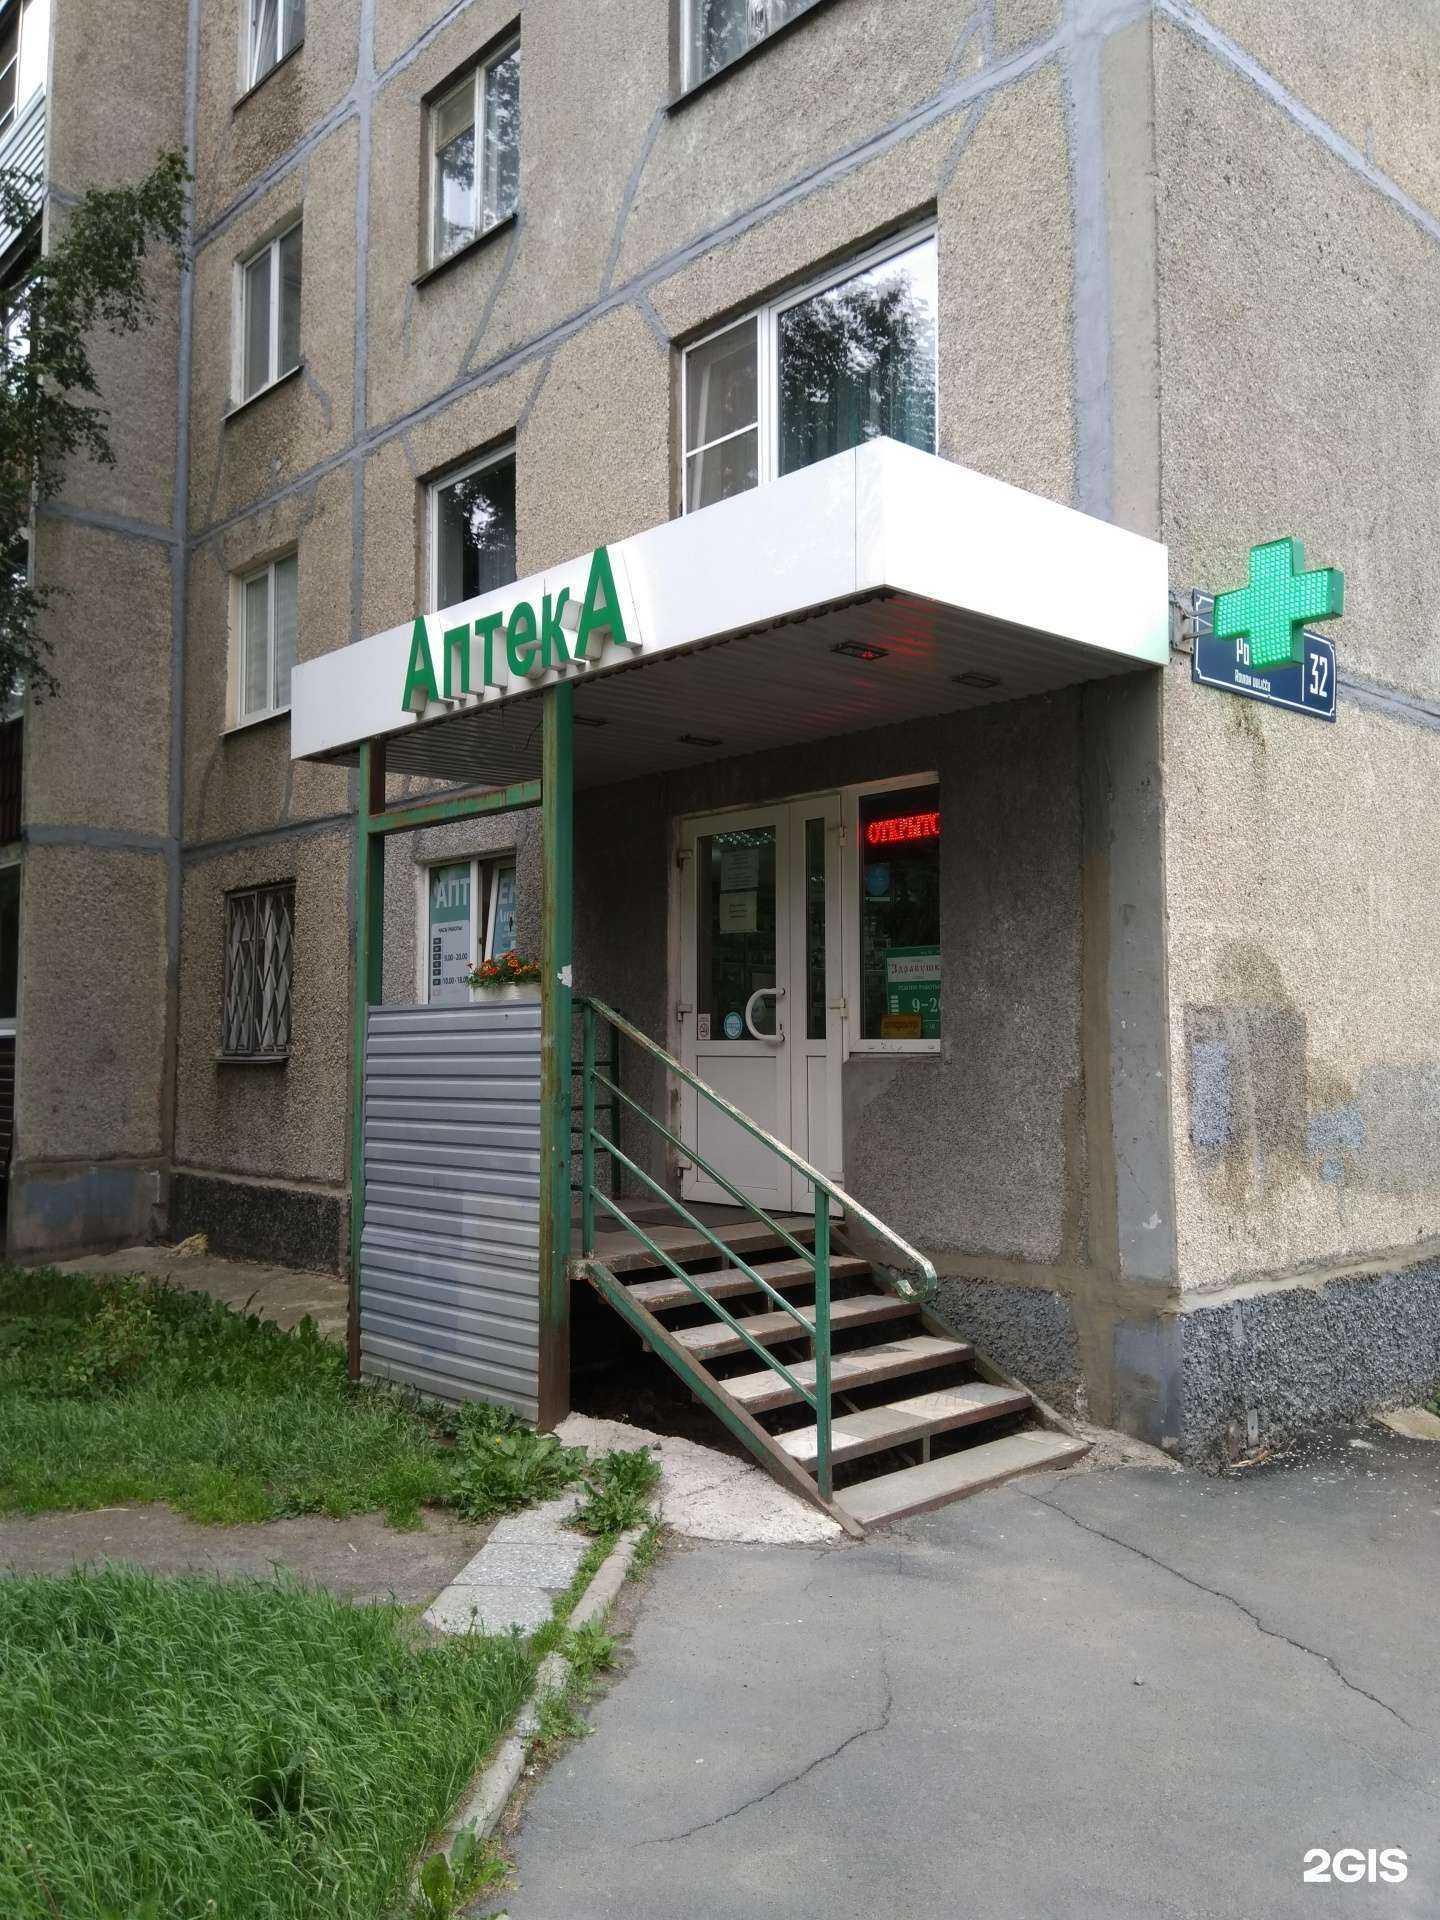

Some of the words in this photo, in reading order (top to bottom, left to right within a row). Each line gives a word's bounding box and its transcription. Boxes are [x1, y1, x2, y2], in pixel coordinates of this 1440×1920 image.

[401, 544, 628, 712] АптекА
[1236, 637, 1250, 666] Ро
[1309, 653, 1328, 697] 32
[891, 962, 941, 977] Здравушк
